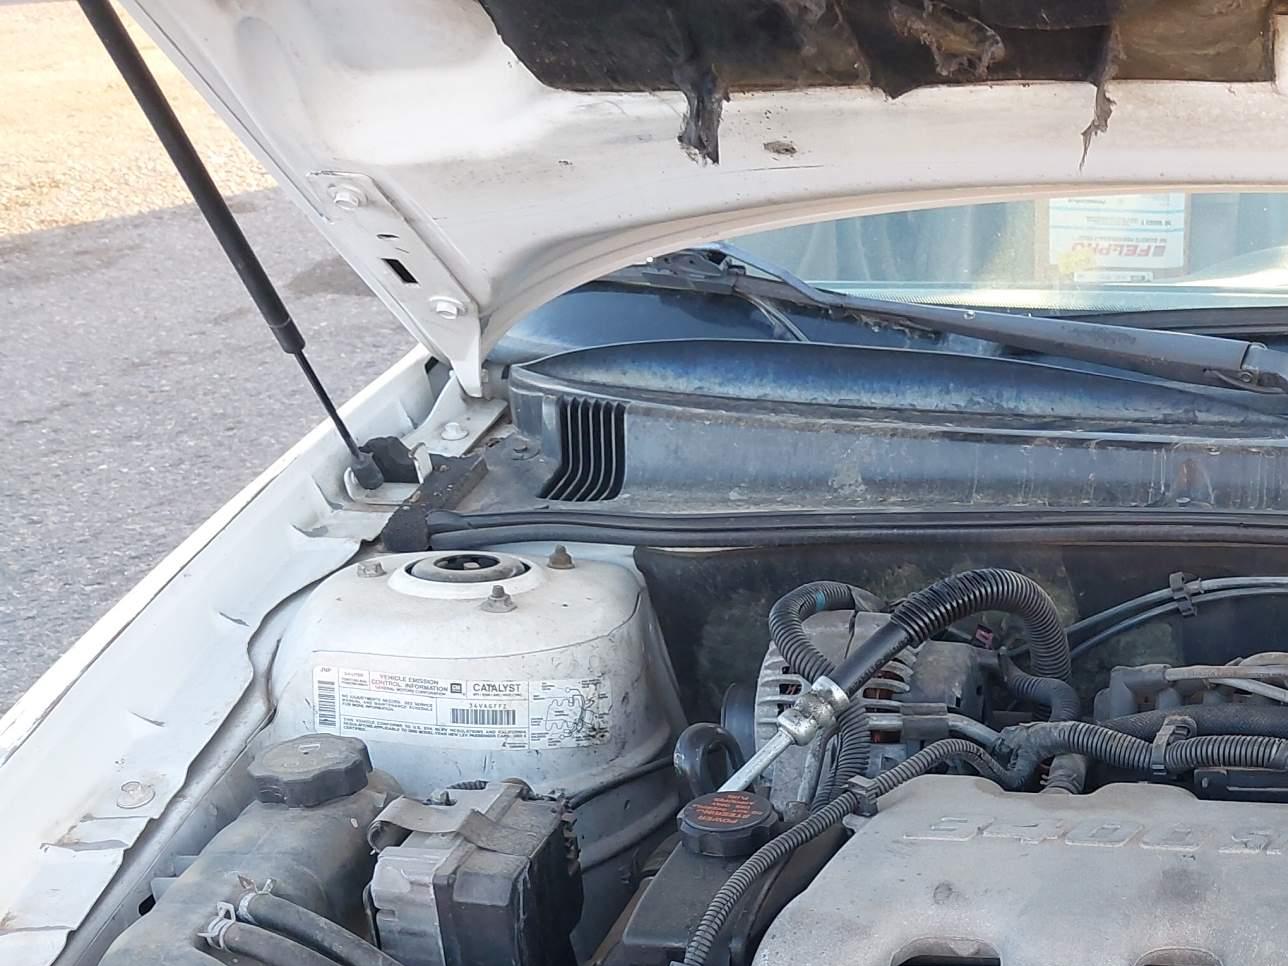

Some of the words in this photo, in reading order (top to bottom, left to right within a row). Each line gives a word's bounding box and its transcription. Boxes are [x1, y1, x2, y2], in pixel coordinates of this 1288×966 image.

[380, 674, 407, 682] VEHICLE
[409, 677, 439, 685] EMISSION
[371, 679, 401, 687] CONTROL
[405, 683, 448, 692] INFORMATION
[473, 684, 520, 692] CATALYST
